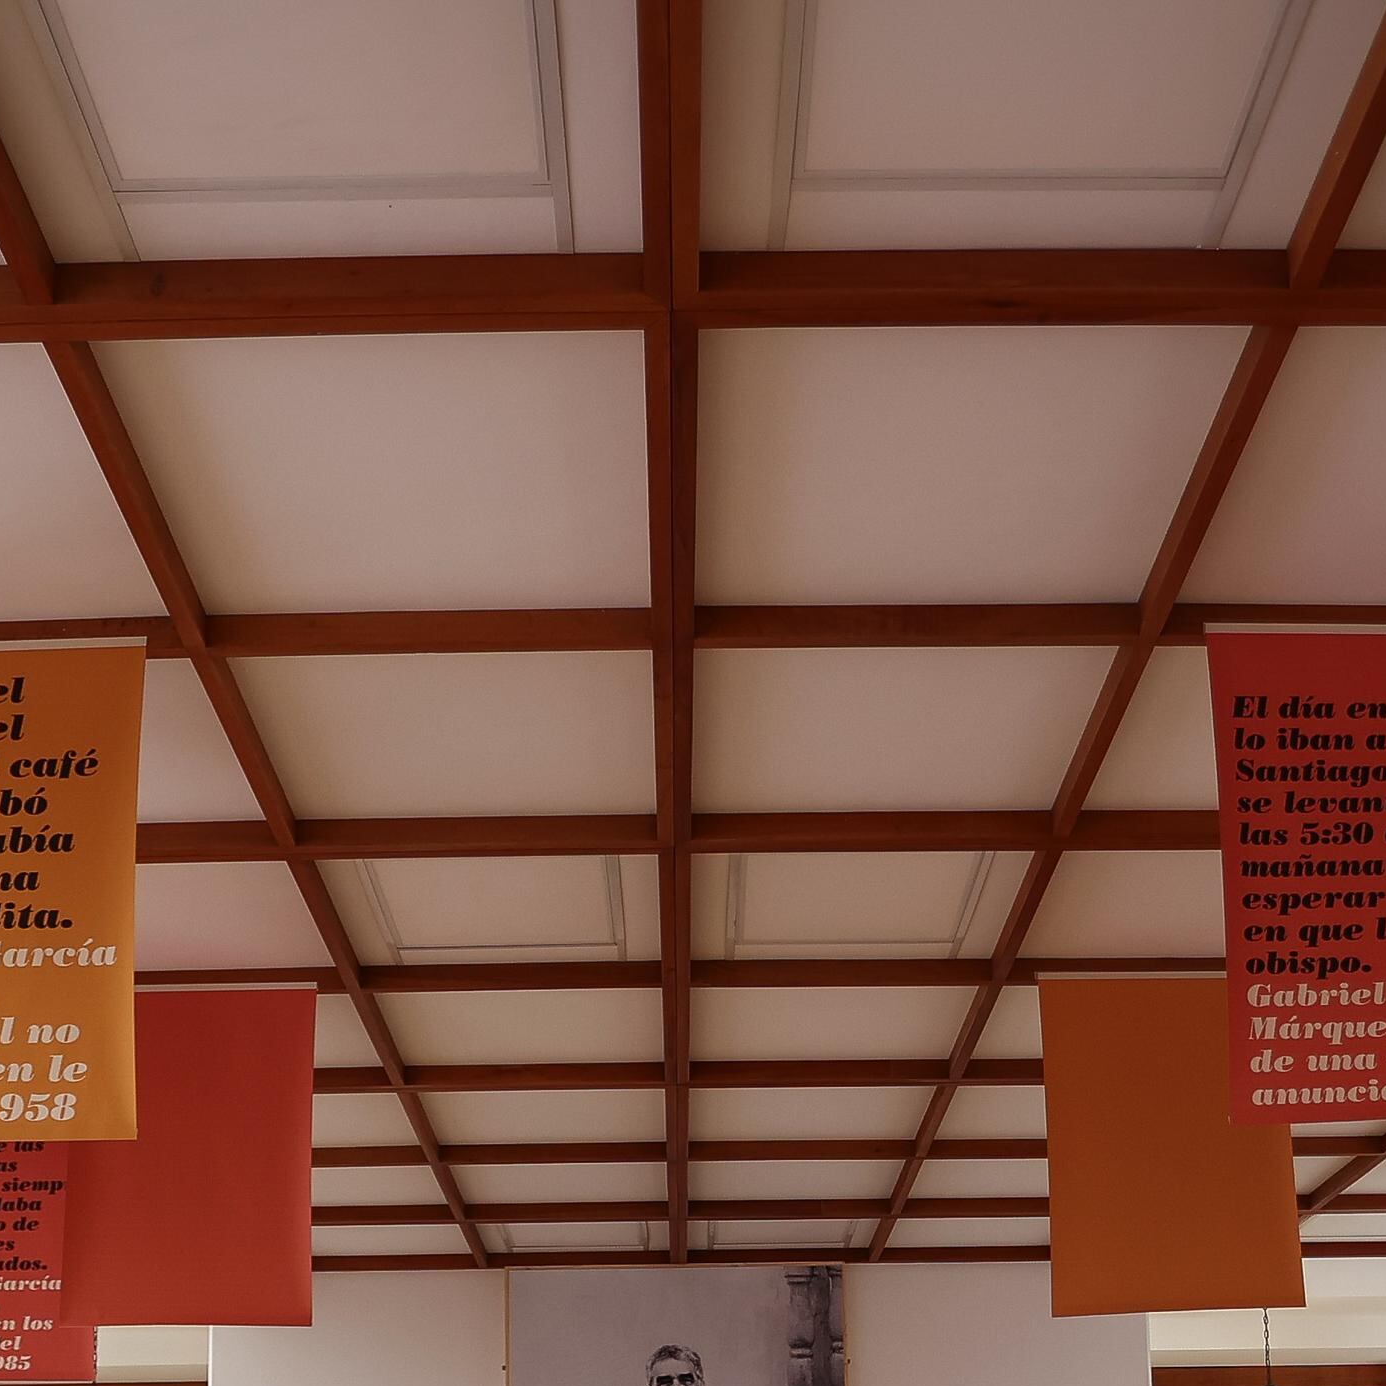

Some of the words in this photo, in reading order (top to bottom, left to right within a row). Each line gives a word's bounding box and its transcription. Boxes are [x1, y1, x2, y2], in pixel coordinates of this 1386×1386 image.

[1233, 695, 1268, 719] El
[1278, 695, 1335, 719] día
[1234, 727, 1266, 750] lo
[1277, 727, 1355, 751] iban
[1365, 734, 1386, 750] a
[9, 748, 99, 779] café
[1245, 951, 1372, 980] obispo.
[1247, 981, 1386, 1007] Gabriel
[26, 1024, 80, 1044] no
[48, 1054, 88, 1083] le
[1250, 1048, 1294, 1073] de
[1307, 1053, 1377, 1072] una
[12, 1217, 39, 1231] de
[22, 1315, 54, 1331] los
